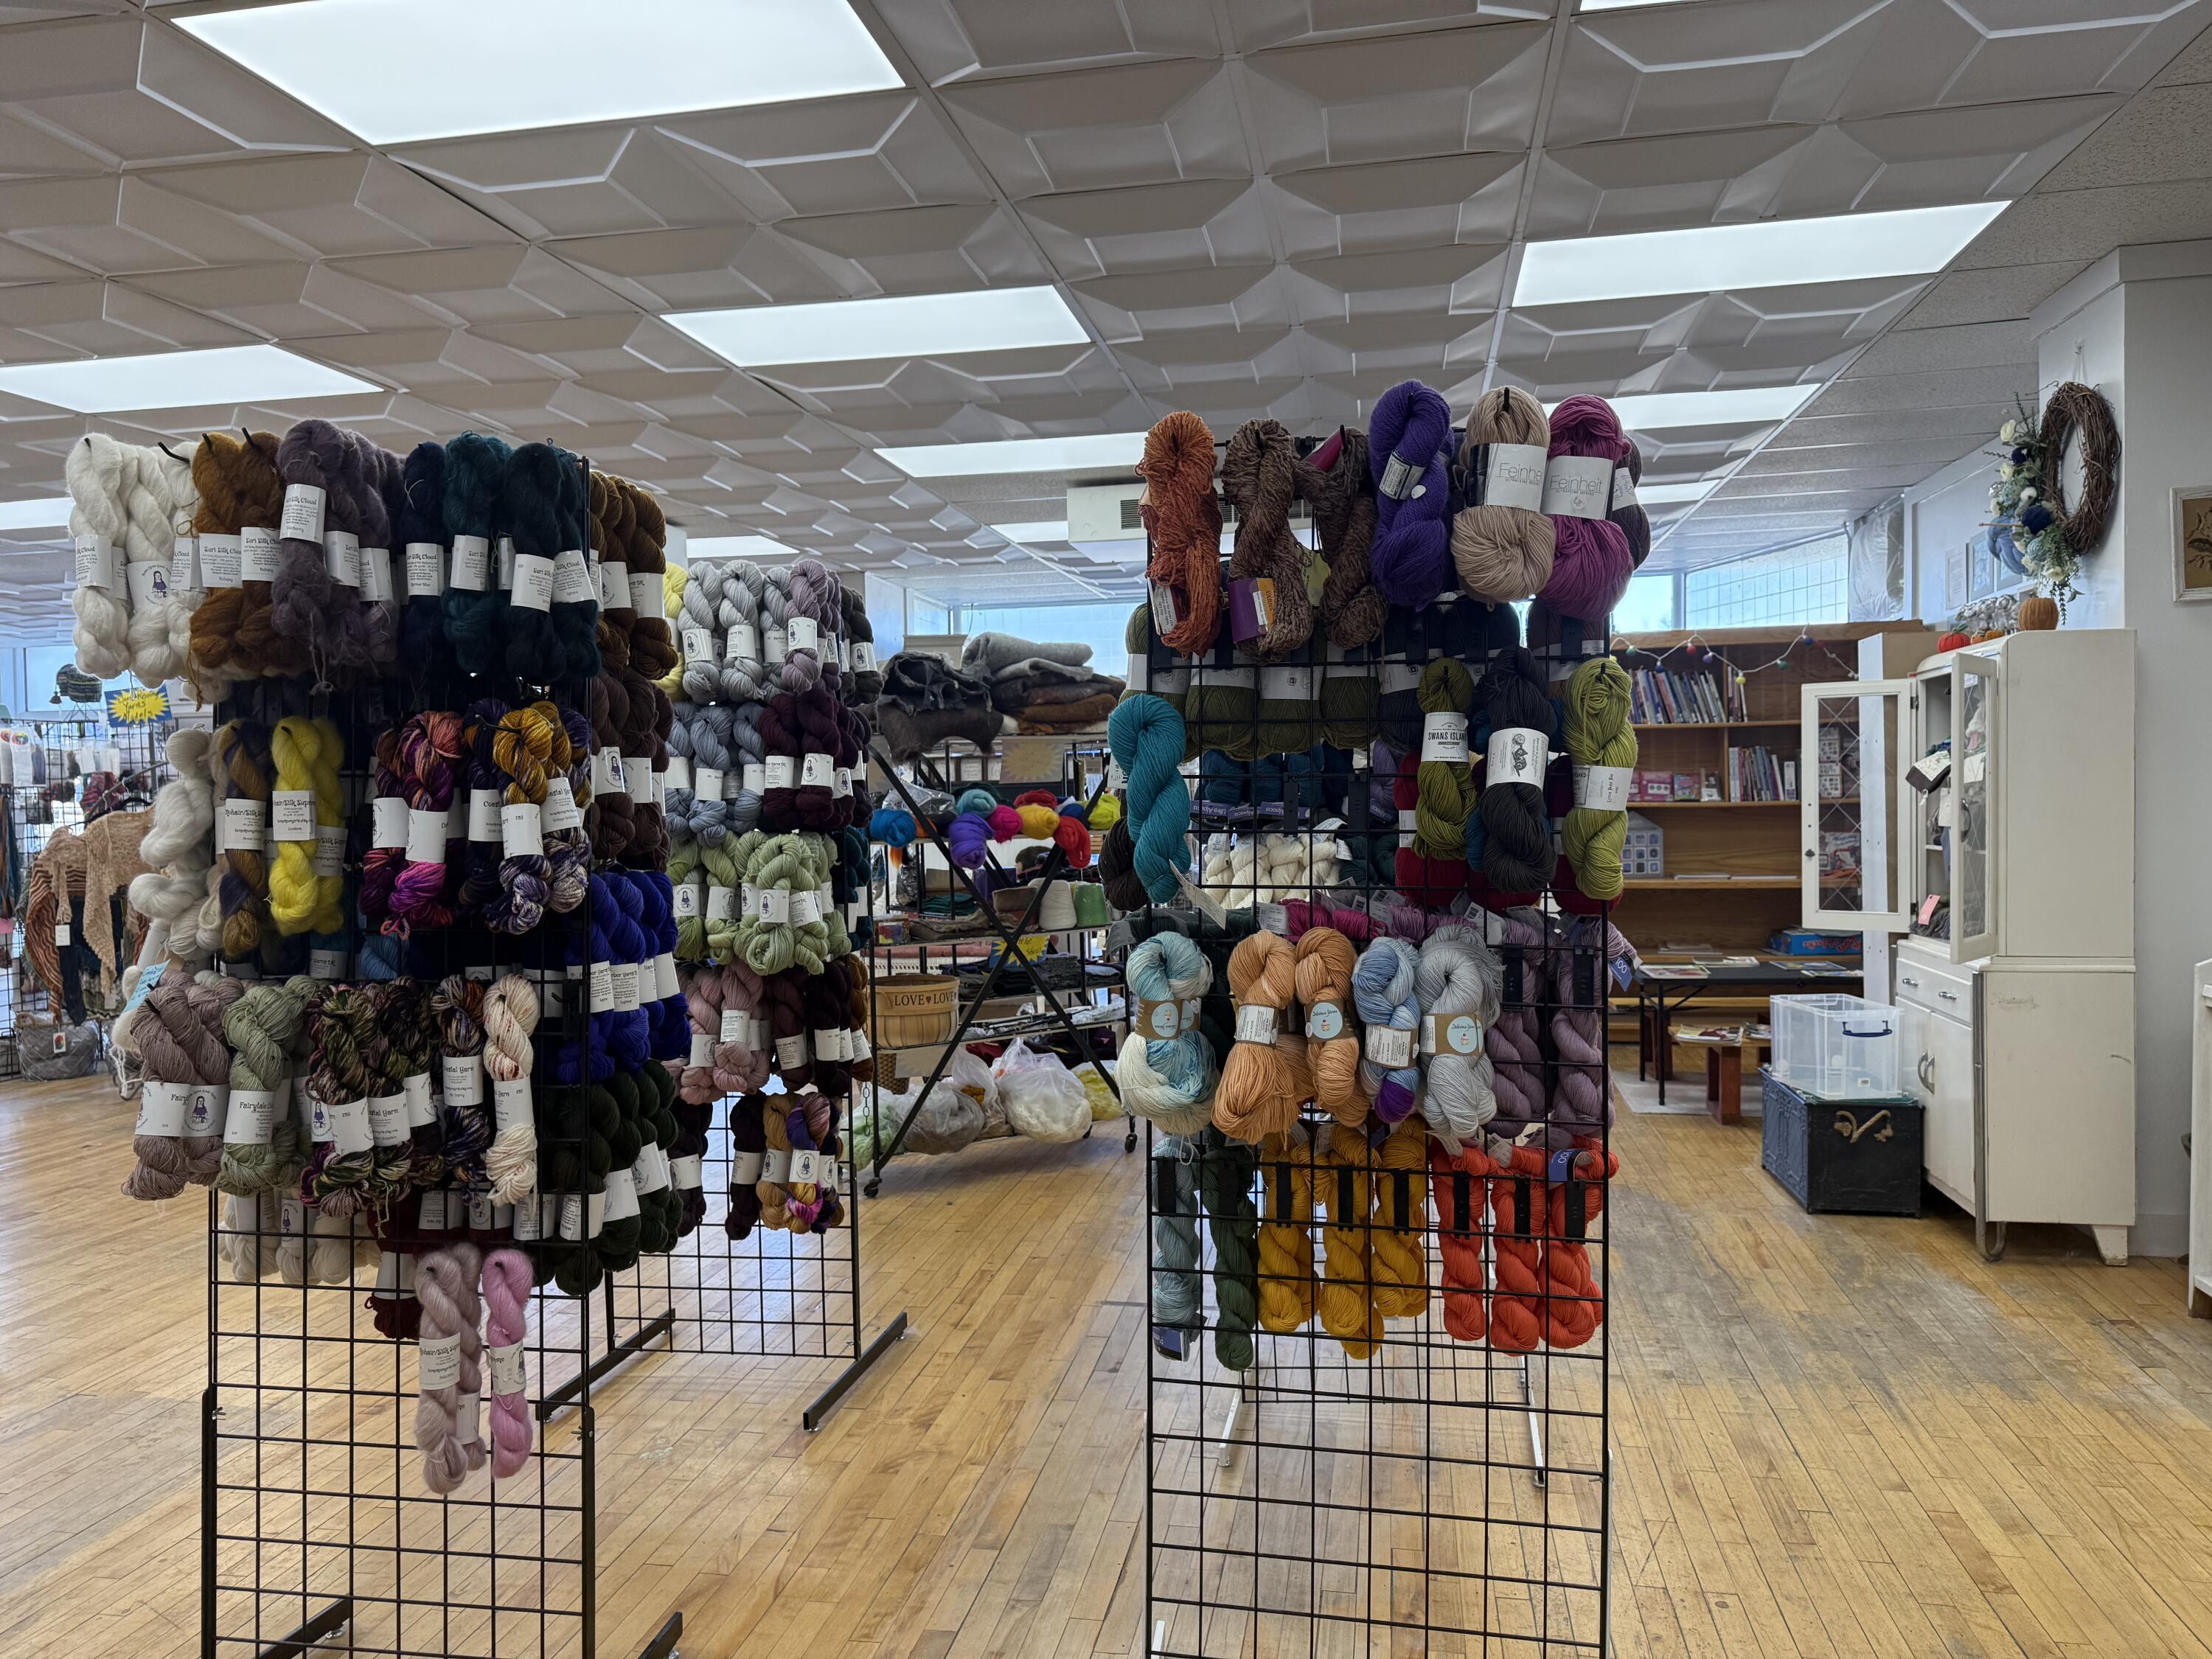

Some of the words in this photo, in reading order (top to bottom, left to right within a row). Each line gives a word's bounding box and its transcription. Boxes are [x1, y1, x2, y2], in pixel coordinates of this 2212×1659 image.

[1499, 462, 1542, 480] Feinhe
[1549, 475, 1603, 493] Feinheit
[301, 497, 317, 505] Cloud
[218, 546, 229, 554] Silk
[1265, 589, 1274, 611] YARNS
[1427, 731, 1448, 740] SWANS
[546, 789, 563, 797] oastal
[273, 799, 296, 807] hair/Silk
[1615, 956, 1627, 973] 100
[894, 994, 925, 1006] LOVE
[933, 990, 954, 1004] LOVE
[171, 1094, 188, 1103] Fairy
[383, 1108, 398, 1117] Yarn
